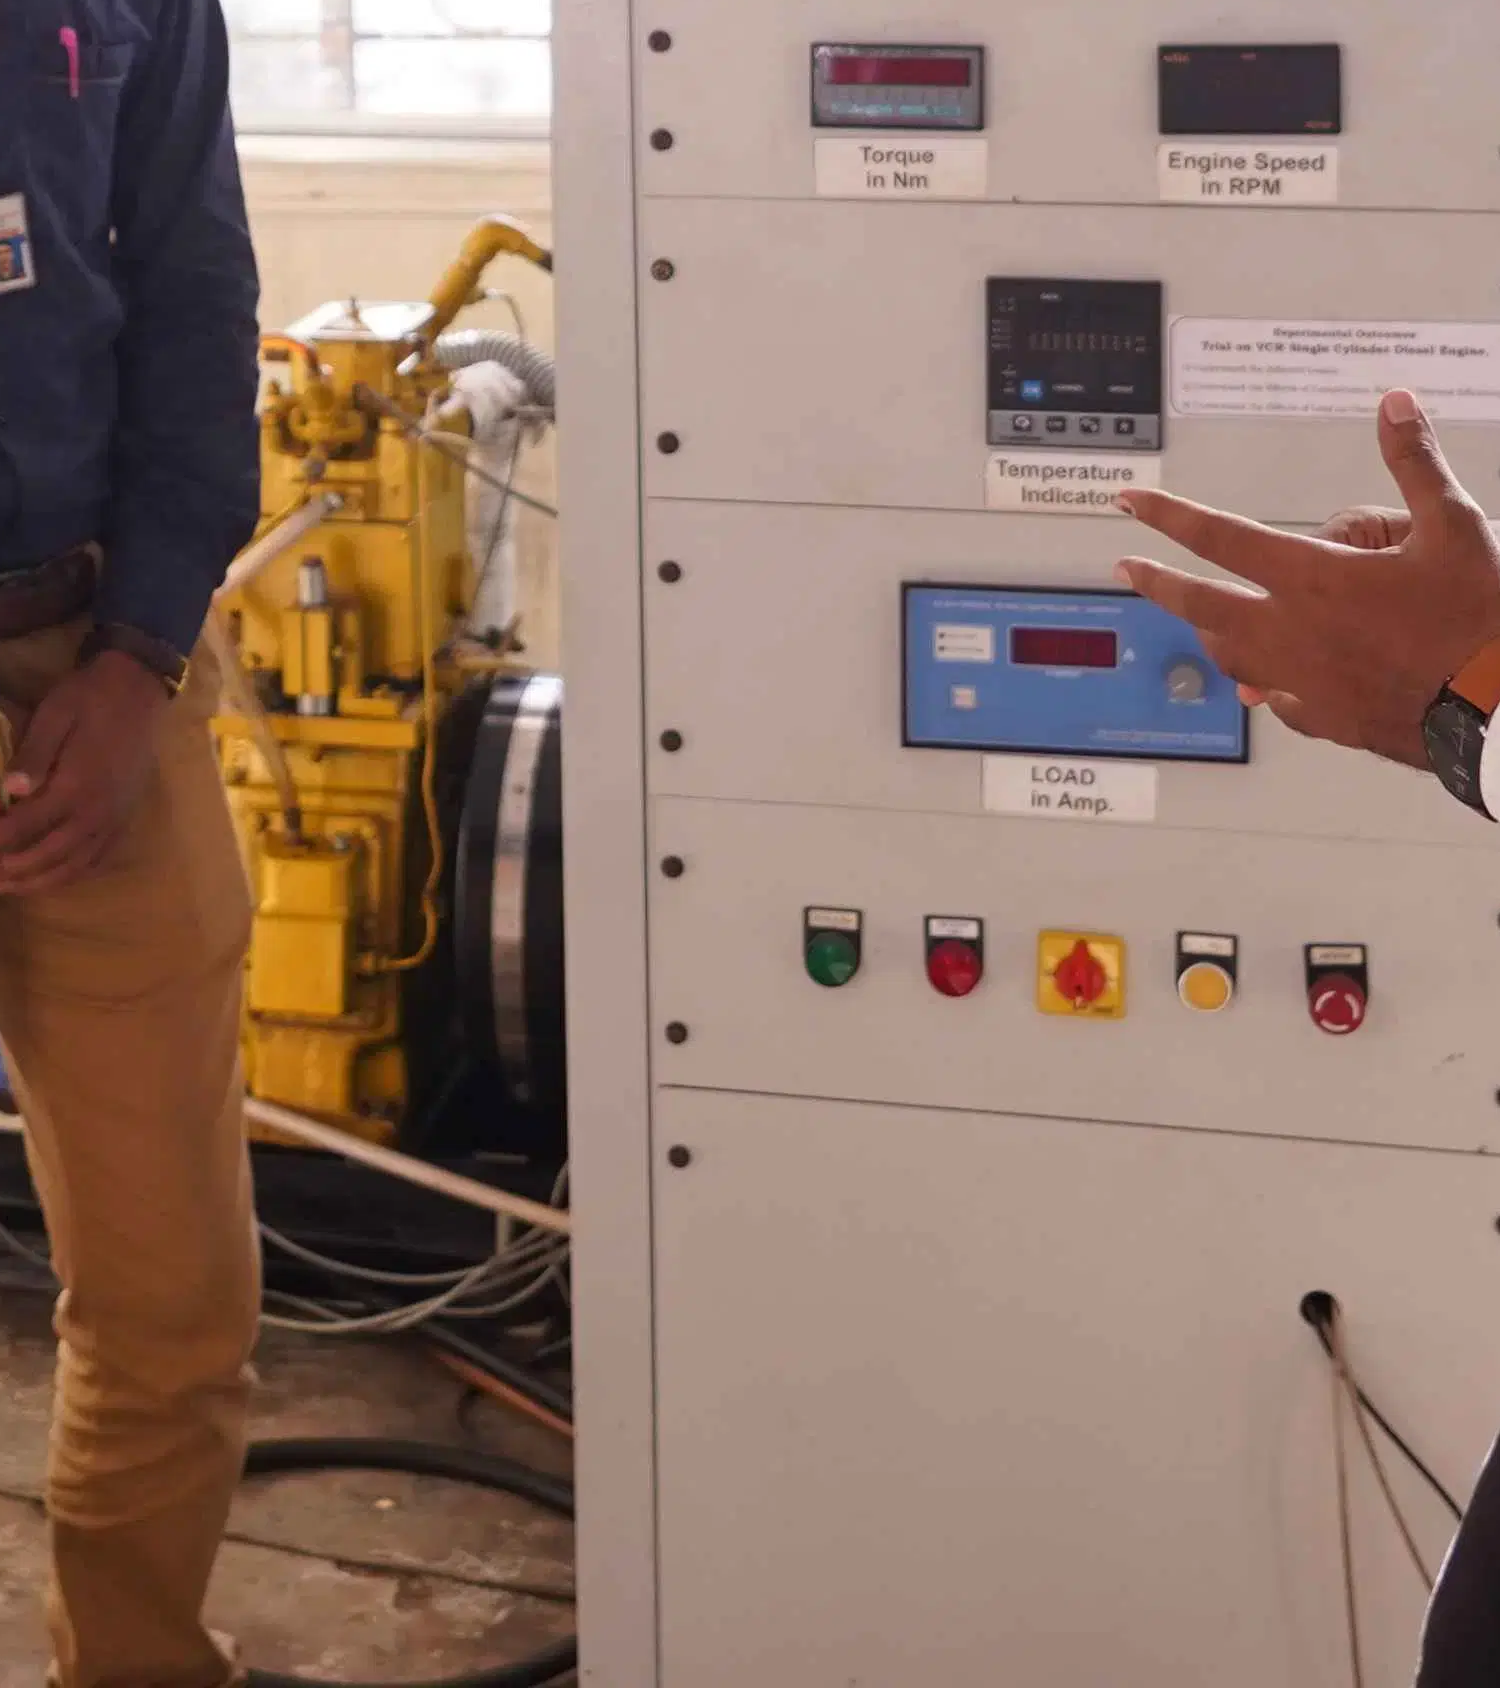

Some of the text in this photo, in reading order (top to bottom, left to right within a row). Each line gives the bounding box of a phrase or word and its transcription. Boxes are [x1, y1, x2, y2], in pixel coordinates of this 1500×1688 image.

[859, 145, 935, 166] Torque
[1168, 151, 1325, 174] Engine Speed
[866, 171, 928, 189] in Nm
[1201, 177, 1281, 195] in RPM
[1257, 342, 1285, 353] VCR
[1333, 343, 1390, 358] Cylinder
[995, 459, 1134, 483] Temperature
[1031, 765, 1096, 786] LOAD
[1031, 789, 1114, 815] in Amp.
